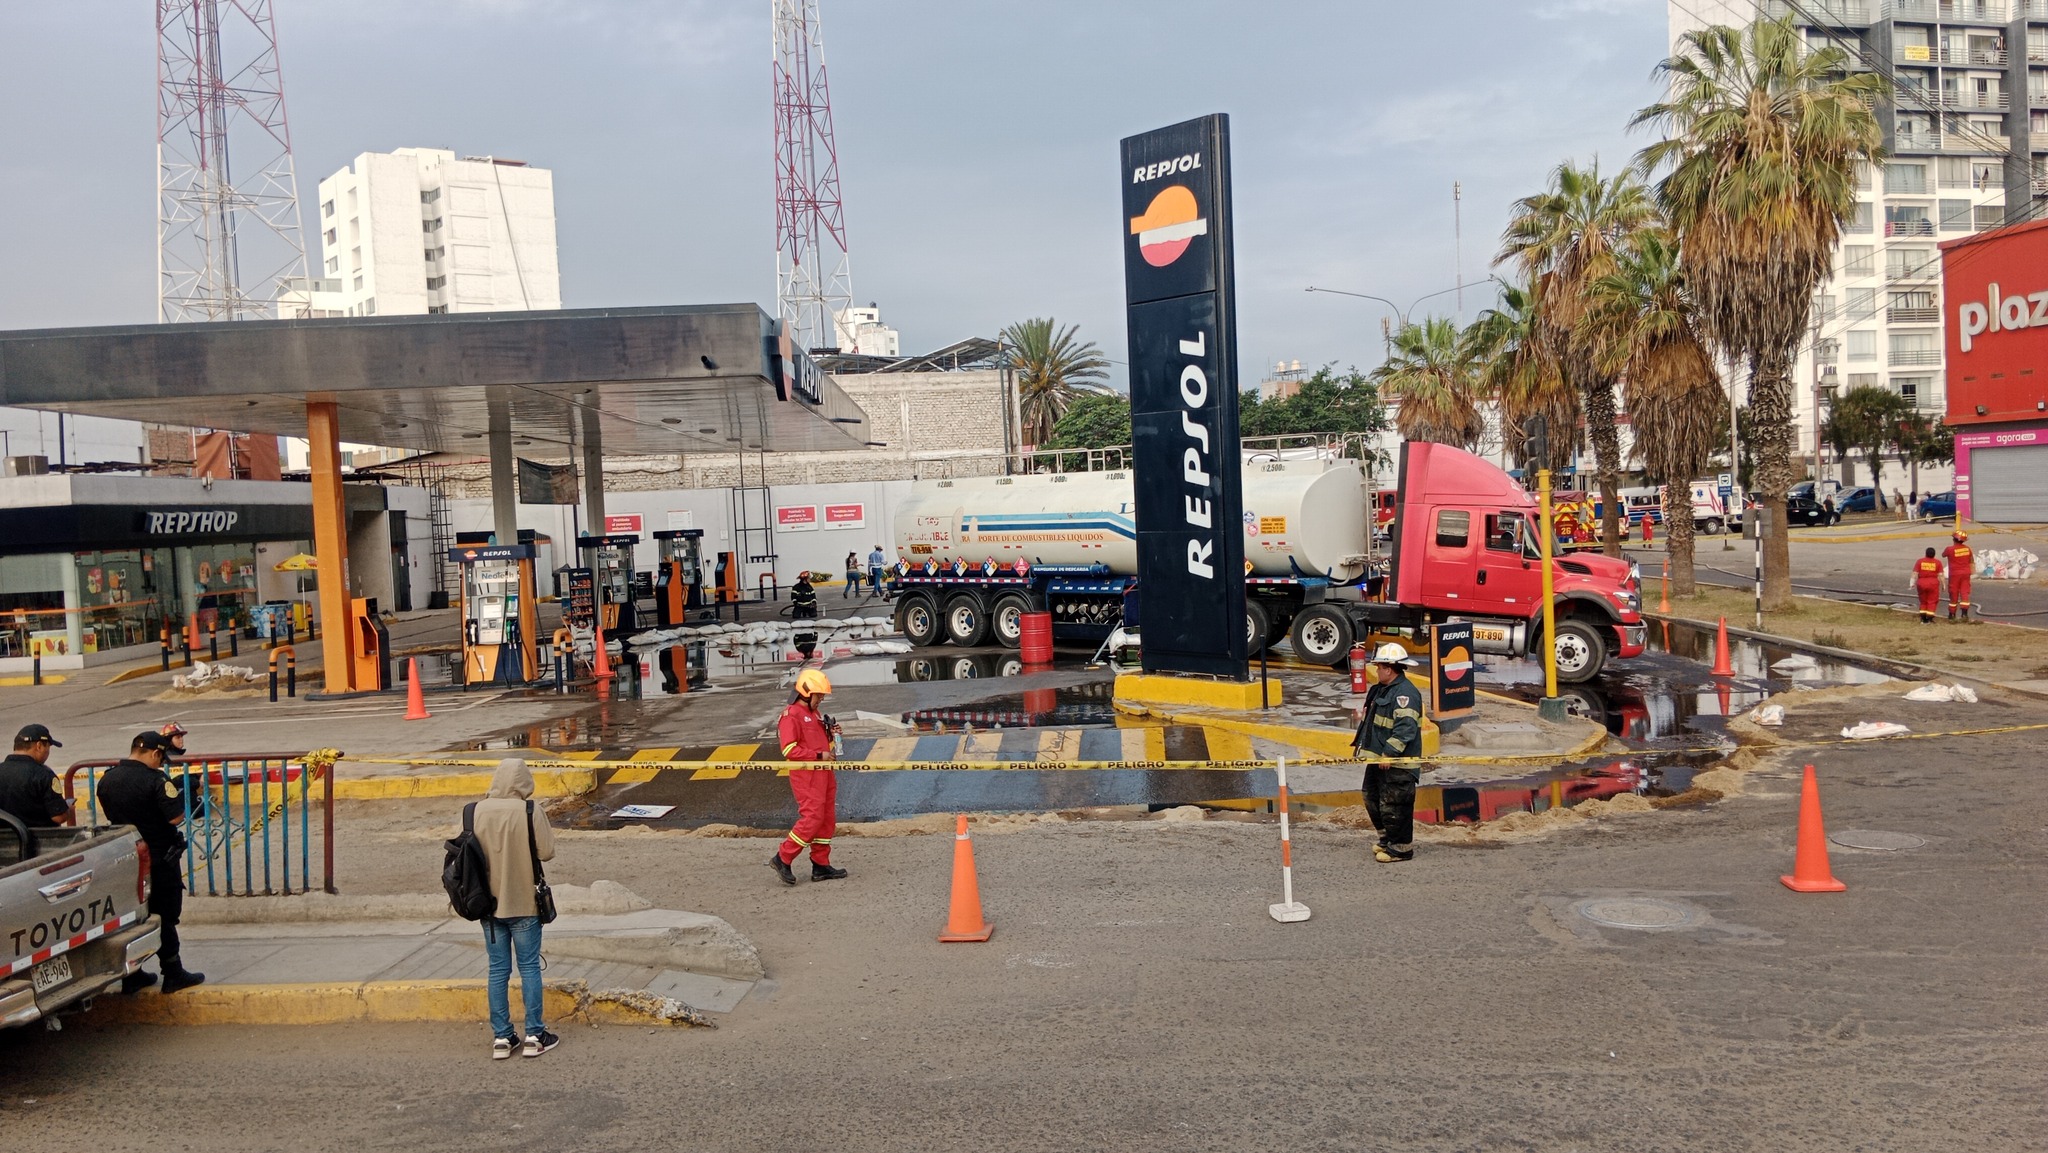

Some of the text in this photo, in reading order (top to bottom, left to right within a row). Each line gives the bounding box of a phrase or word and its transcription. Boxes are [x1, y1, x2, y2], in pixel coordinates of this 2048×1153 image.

[1133, 152, 1202, 184] REPSOL
[1996, 434, 2021, 445] agora
[1179, 331, 1214, 579] REPSOL
[150, 511, 238, 534] REPSHOP
[1561, 527, 1572, 535] 26
[1001, 534, 1010, 542] DE
[1012, 533, 1066, 542] COMBUSTIBLES
[1067, 532, 1104, 542] LIQUIDOS
[1443, 630, 1470, 641] REPSOL
[1009, 762, 1067, 770] PELIGRO
[1107, 761, 1165, 769] PELIGRO
[10, 895, 116, 956] TOYOTA
[36, 961, 69, 989] EAE-949
